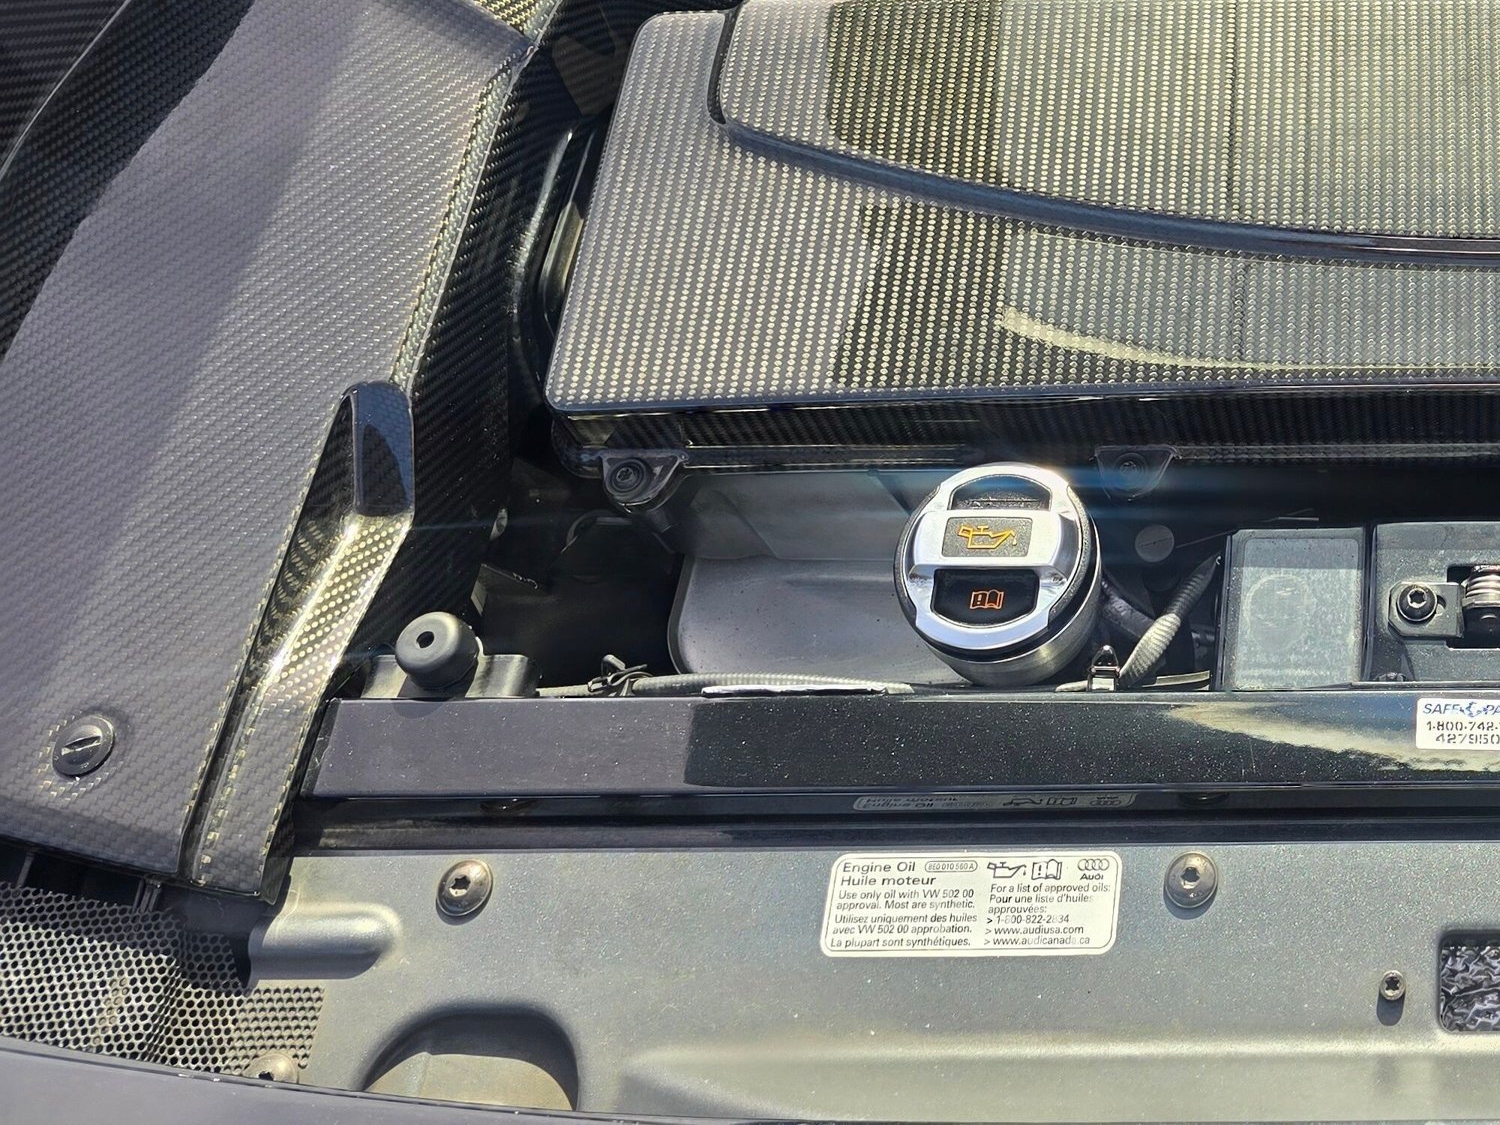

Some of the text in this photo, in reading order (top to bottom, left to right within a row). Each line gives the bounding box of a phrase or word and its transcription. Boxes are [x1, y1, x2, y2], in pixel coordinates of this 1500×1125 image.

[1422, 703, 1460, 715] SAFE
[842, 861, 916, 874] Engine Oil
[841, 875, 936, 886] Huile moteur
[838, 889, 975, 901] Use only oil with VW 502 00
[990, 883, 1111, 895] For a list of approved oils:
[990, 894, 1012, 903] Pour
[1014, 895, 1033, 903] une
[1035, 894, 1054, 903] liste
[836, 899, 975, 911] approval. Most are synthetic.
[988, 905, 1047, 915] approuvées:
[834, 913, 978, 925] Utilisez uniquement des huiles
[833, 924, 972, 935] avec VW 502 00 approbation.
[994, 925, 1084, 935] www.audiusa.com
[831, 936, 971, 948] La plupart sont synthétiques.
[993, 935, 1090, 945] www.audicanada.ca
